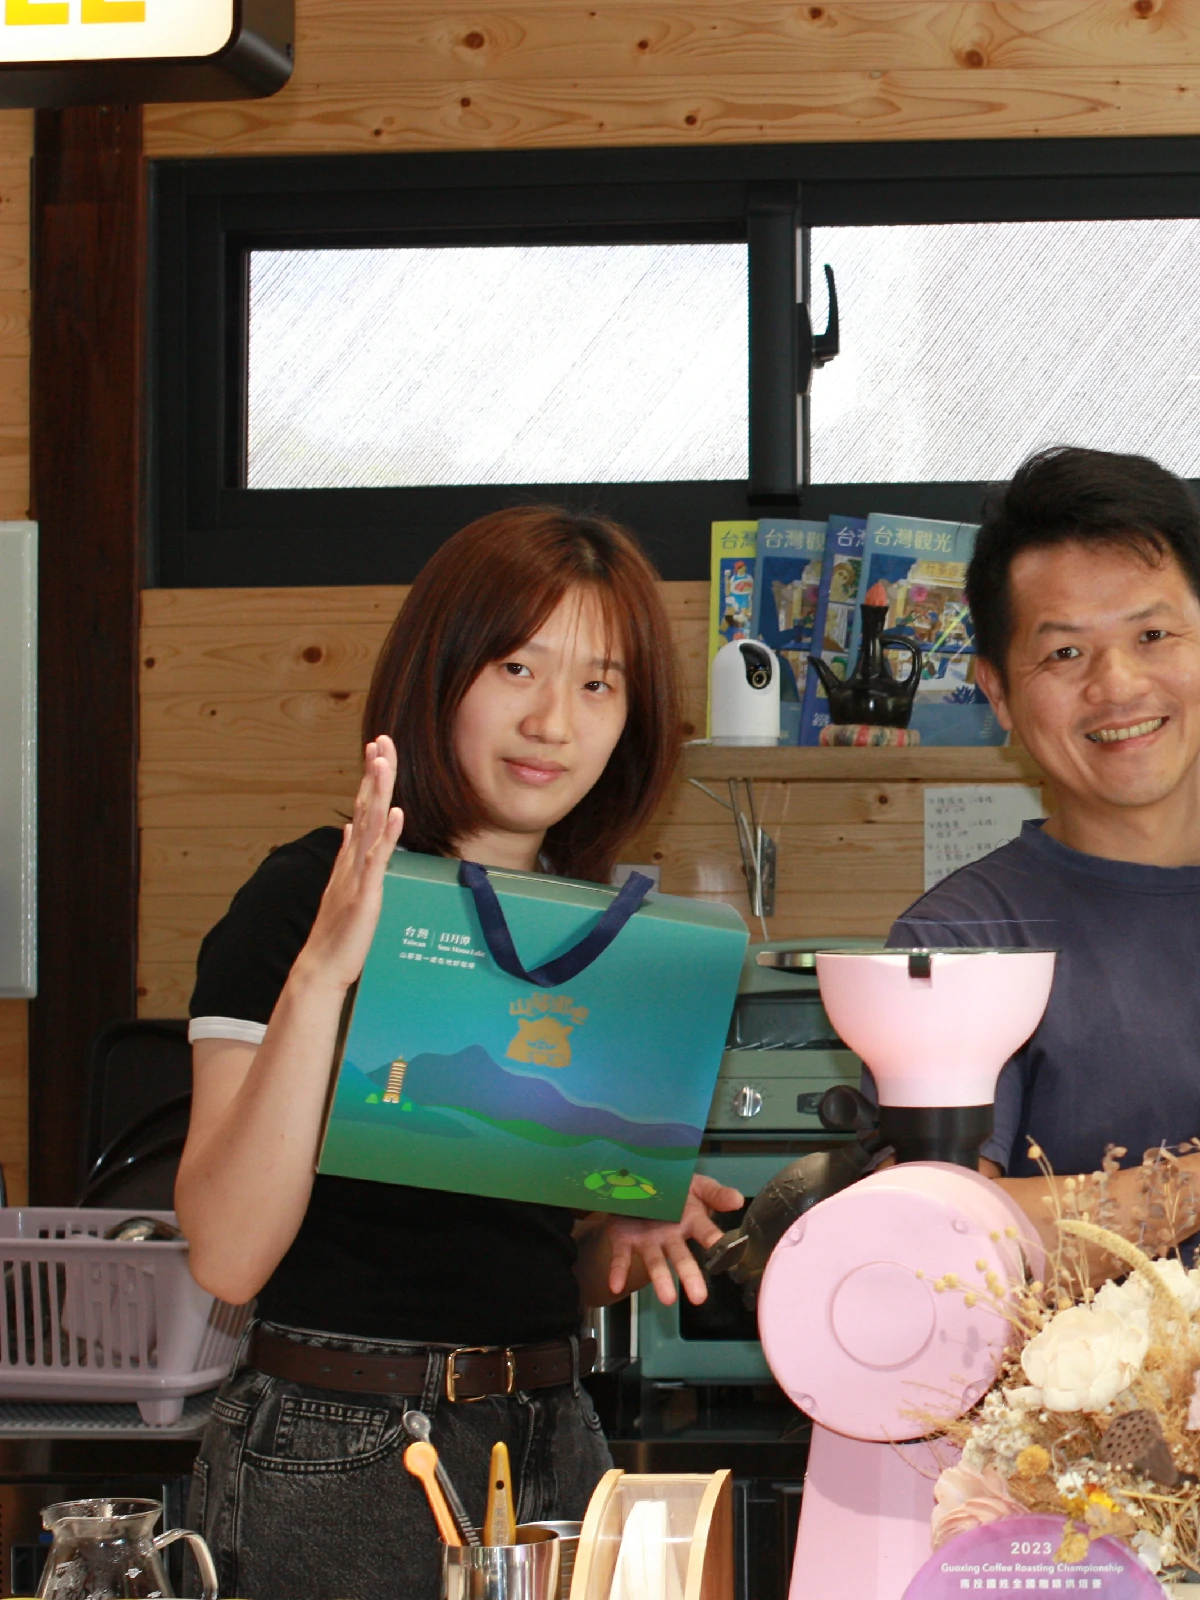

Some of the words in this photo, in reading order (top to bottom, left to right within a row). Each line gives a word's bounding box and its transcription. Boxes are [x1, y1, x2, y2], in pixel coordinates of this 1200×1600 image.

[873, 524, 953, 553] 台灣觀光
[405, 925, 430, 939] 台灣
[439, 932, 472, 946] 日月潭
[402, 938, 427, 948] Taiwan
[437, 943, 450, 952] Sun
[1011, 1541, 1052, 1555] 2023
[940, 1562, 980, 1574] Guoxing
[982, 1562, 1013, 1573] Coffee
[1014, 1562, 1055, 1574] Roasting
[1056, 1562, 1125, 1575] Championship
